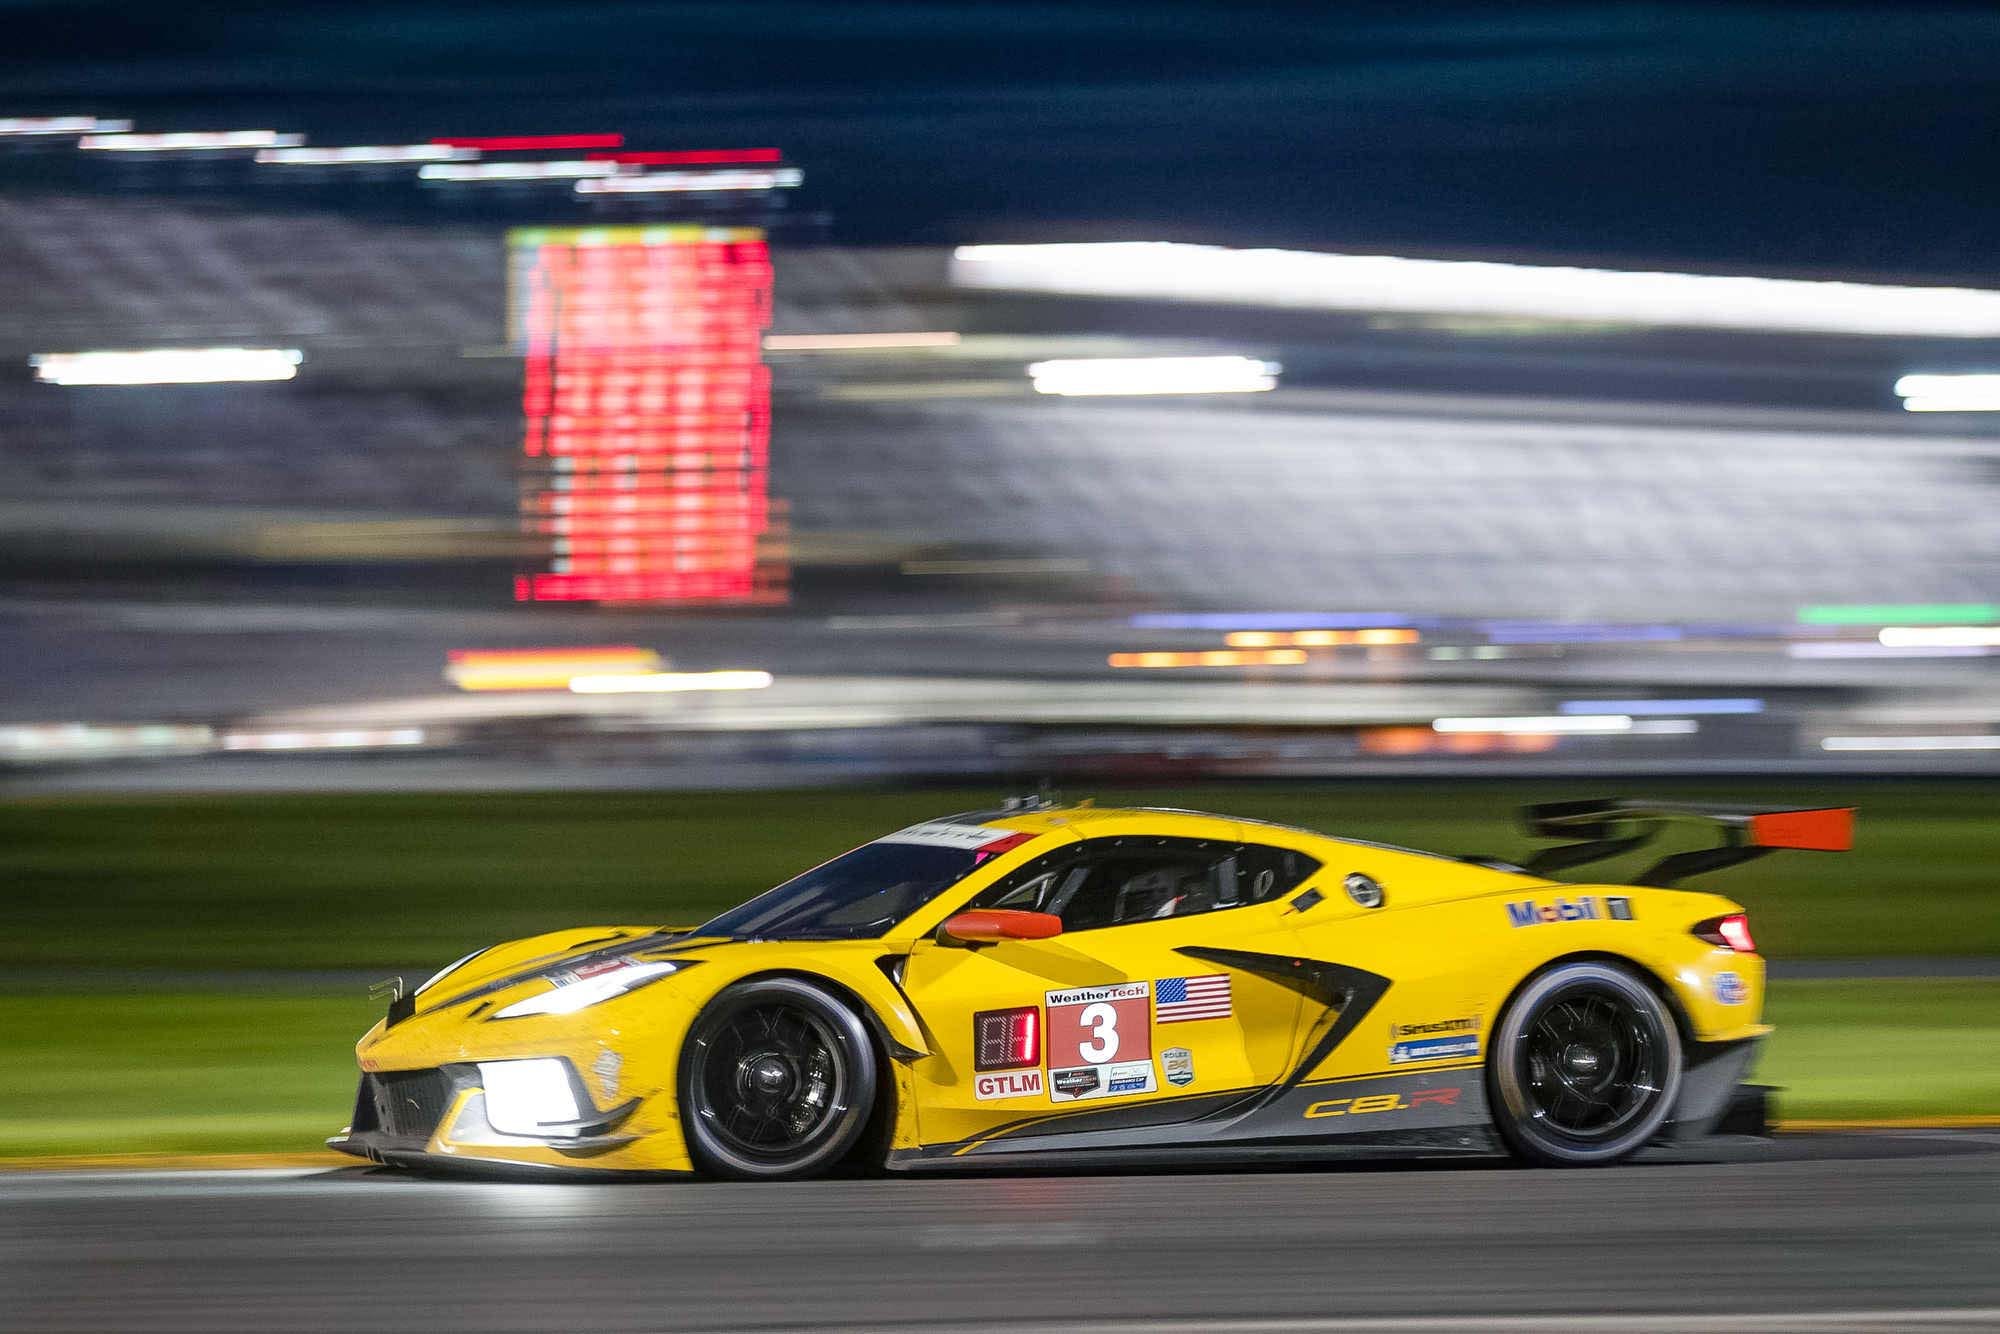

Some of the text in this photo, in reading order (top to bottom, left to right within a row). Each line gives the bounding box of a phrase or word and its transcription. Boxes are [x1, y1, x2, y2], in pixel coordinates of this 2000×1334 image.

[1506, 897, 1598, 928] Mobil
[1049, 986, 1145, 1004] WeatherTech
[1079, 1002, 1120, 1064] 3
[978, 1074, 1041, 1096] GTLM
[1303, 1087, 1463, 1119] C8.R
